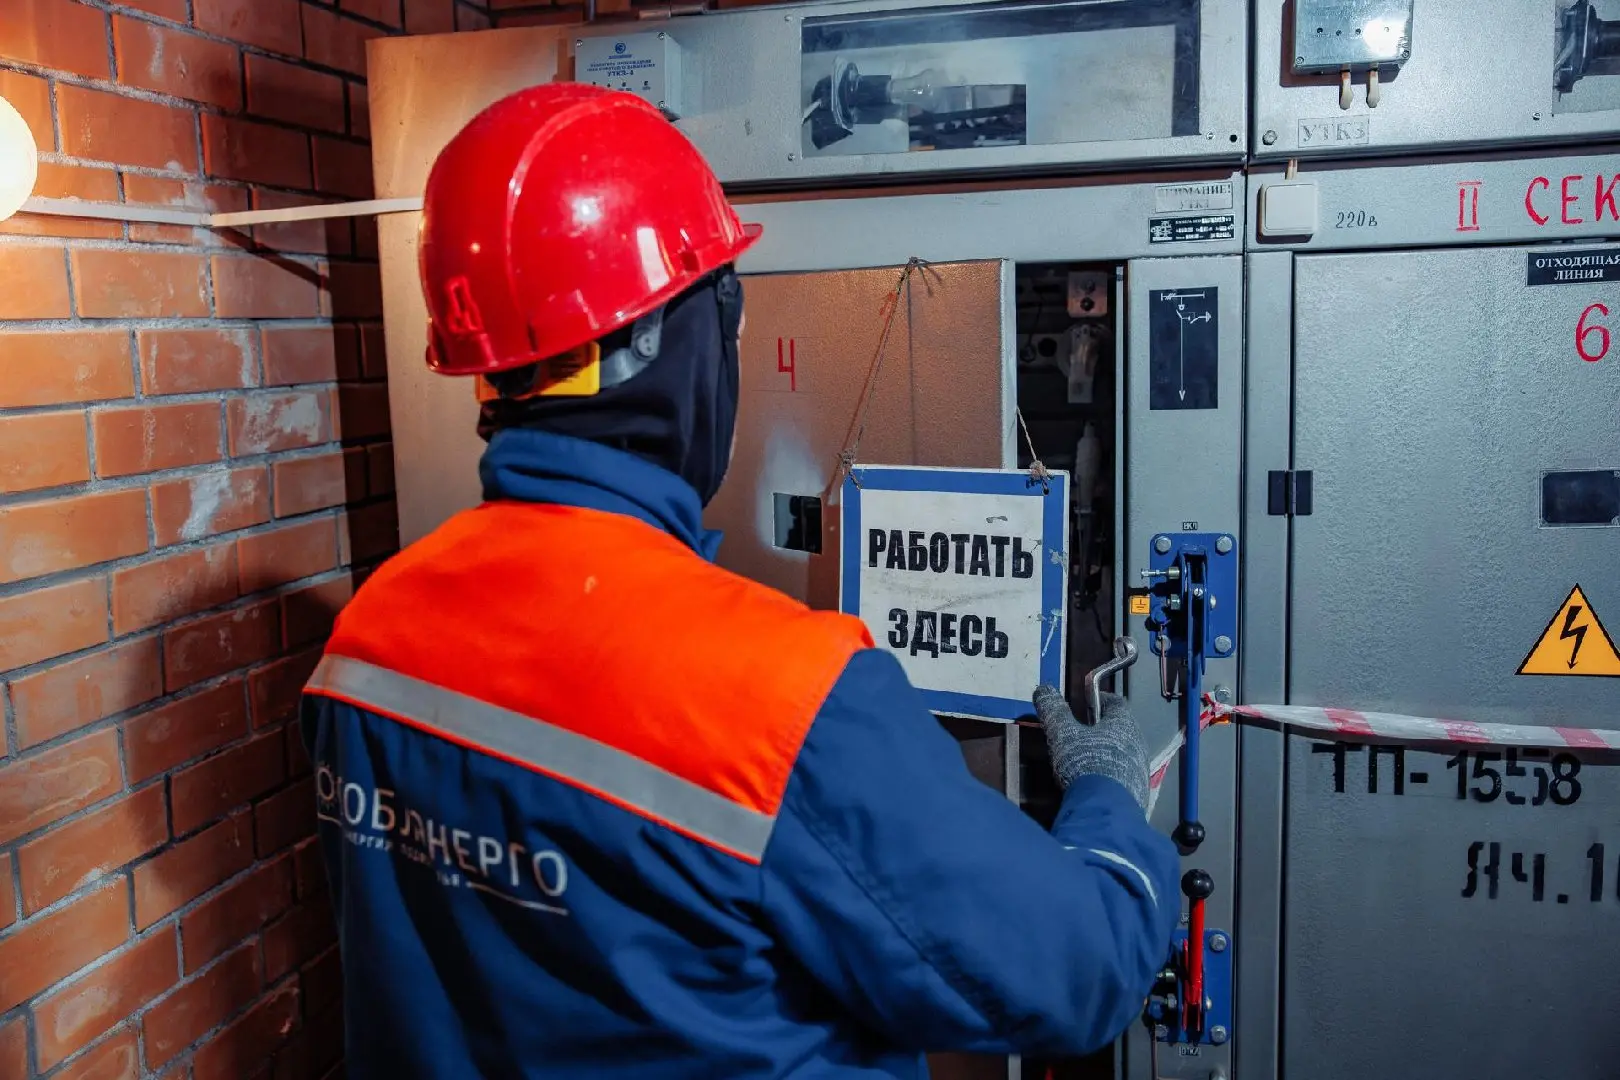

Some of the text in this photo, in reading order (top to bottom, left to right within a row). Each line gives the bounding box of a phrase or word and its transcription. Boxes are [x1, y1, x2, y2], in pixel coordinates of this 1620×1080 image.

[1301, 121, 1366, 141] УТКЗ
[1159, 184, 1231, 196] МАНИЕ!
[1525, 174, 1620, 227] СЕК
[1535, 254, 1620, 269] ОТХОДЯЩАЯ
[1554, 268, 1604, 281] ЛИНИЯ
[1575, 303, 1611, 363] 6
[777, 336, 797, 392] 4
[868, 528, 1034, 579] РАБОТАТЬ
[888, 607, 1009, 659] ЗДЕСЬ
[316, 765, 568, 897] ООБЛНЕРГО
